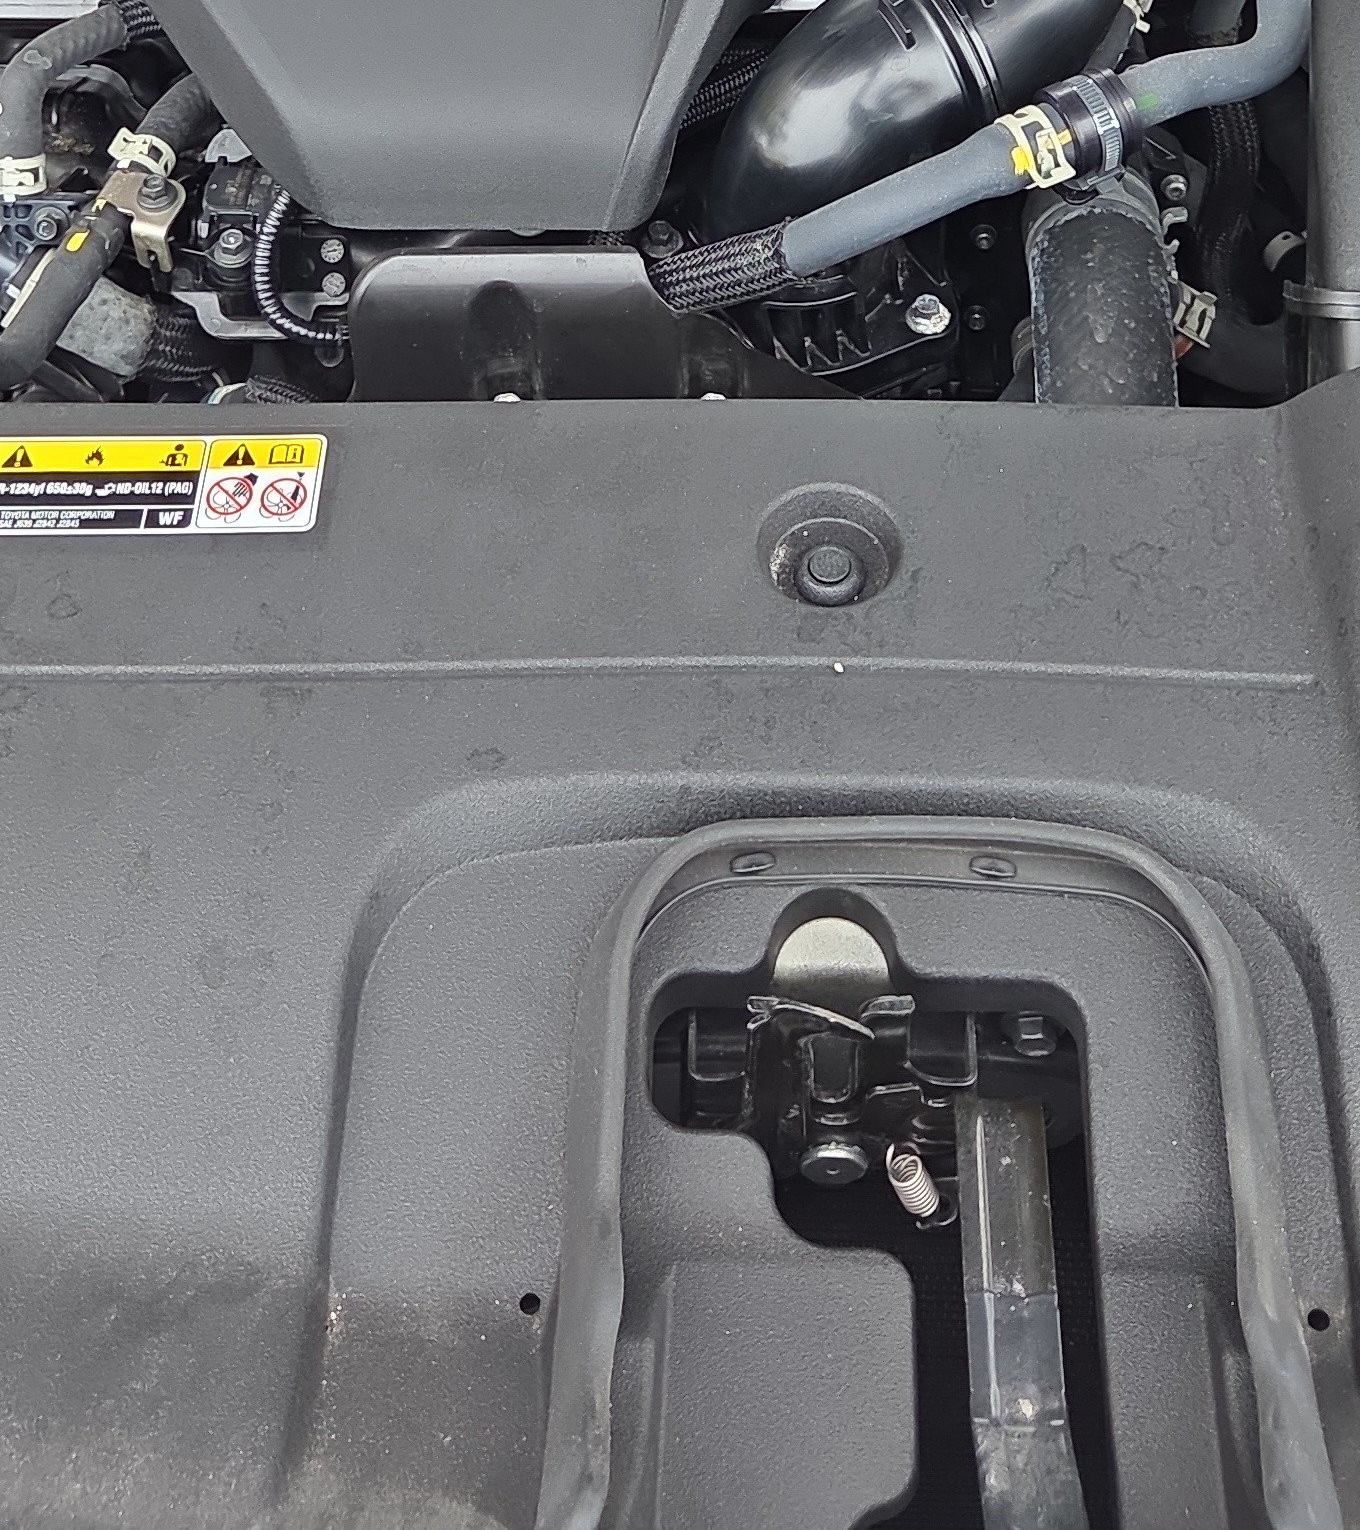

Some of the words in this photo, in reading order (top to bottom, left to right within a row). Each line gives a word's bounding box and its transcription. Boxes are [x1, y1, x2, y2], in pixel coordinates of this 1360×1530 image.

[0, 511, 30, 520] TOYOTA
[30, 511, 60, 520] MOTOR
[60, 510, 115, 520] CORPORATION
[158, 511, 185, 526] WF
